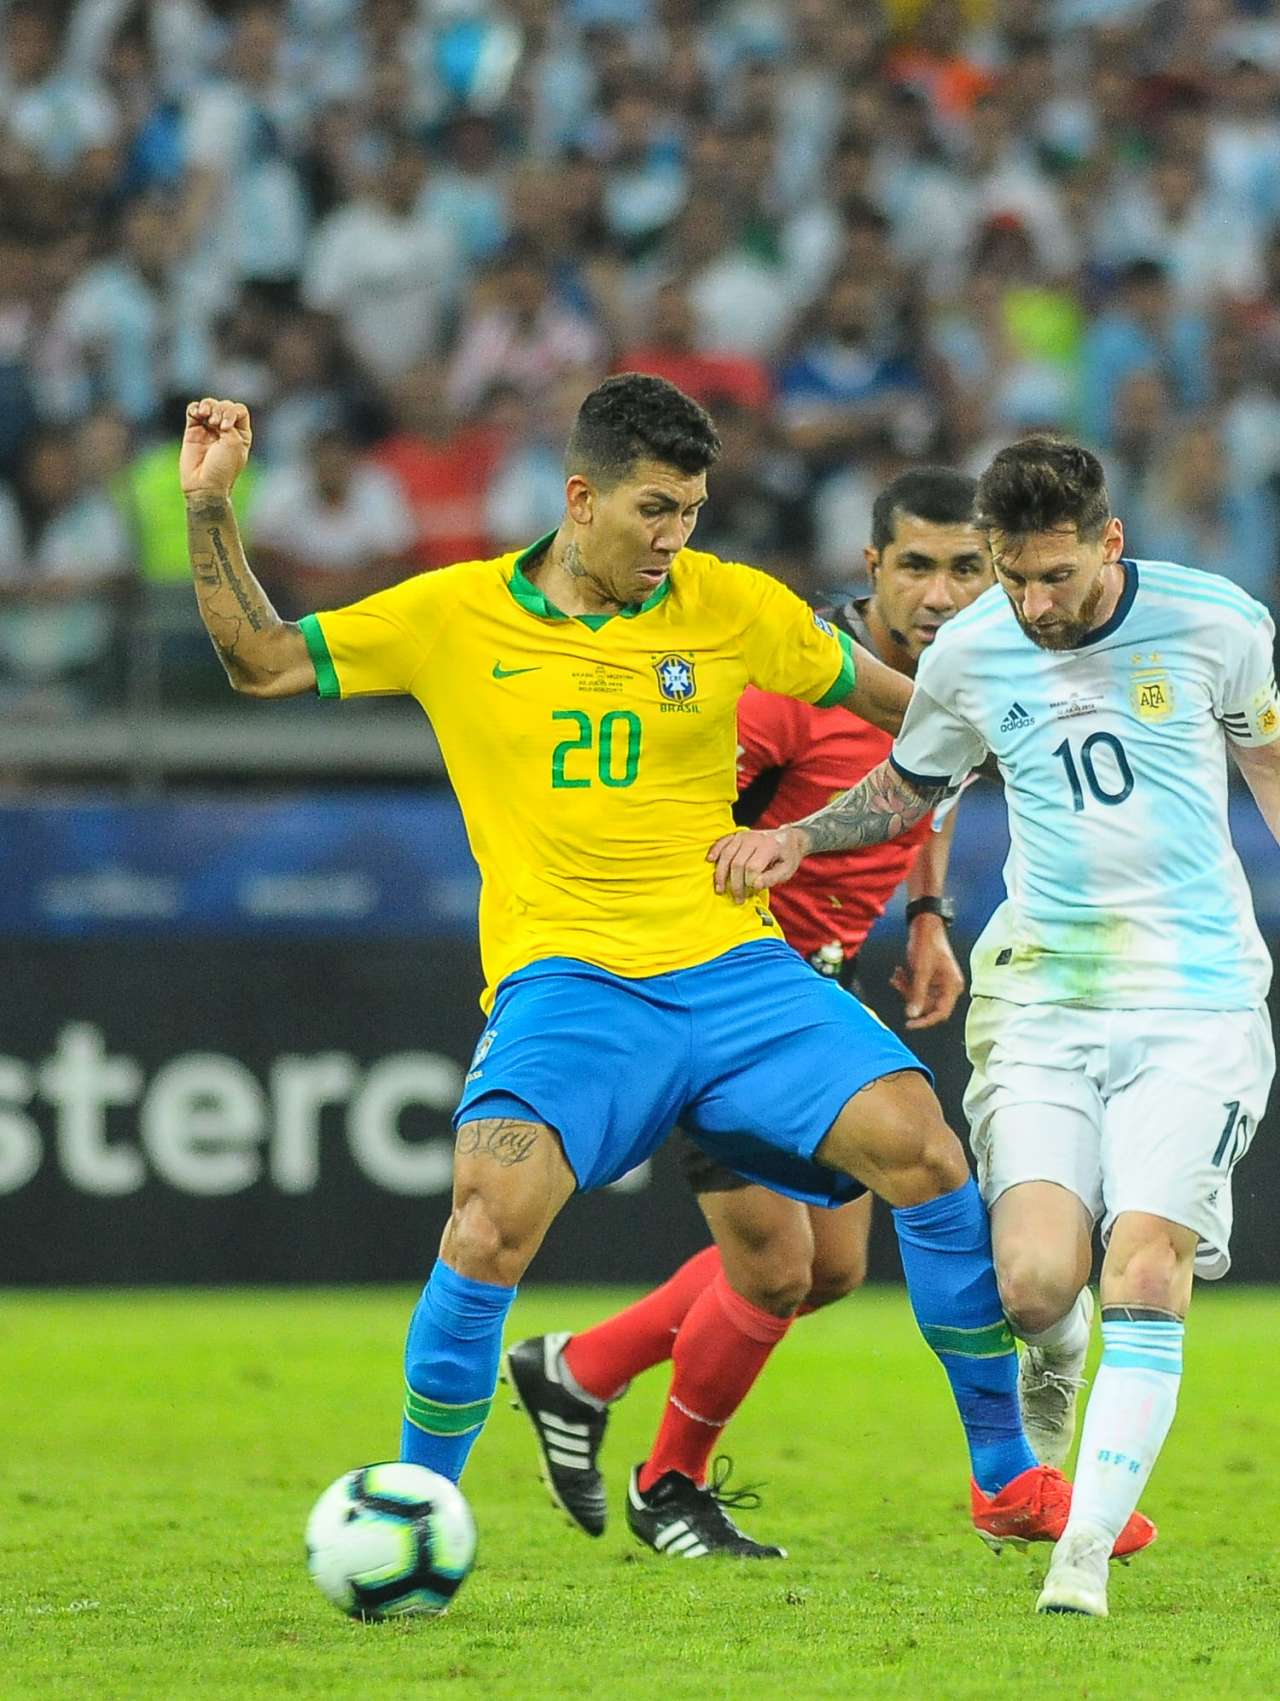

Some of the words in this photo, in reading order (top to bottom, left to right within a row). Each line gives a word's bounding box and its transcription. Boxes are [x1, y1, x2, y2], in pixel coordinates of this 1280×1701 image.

[660, 703, 703, 713] BRASIL
[1000, 717, 1036, 733] adidas
[552, 710, 642, 789] 20
[1051, 731, 1135, 812] 10
